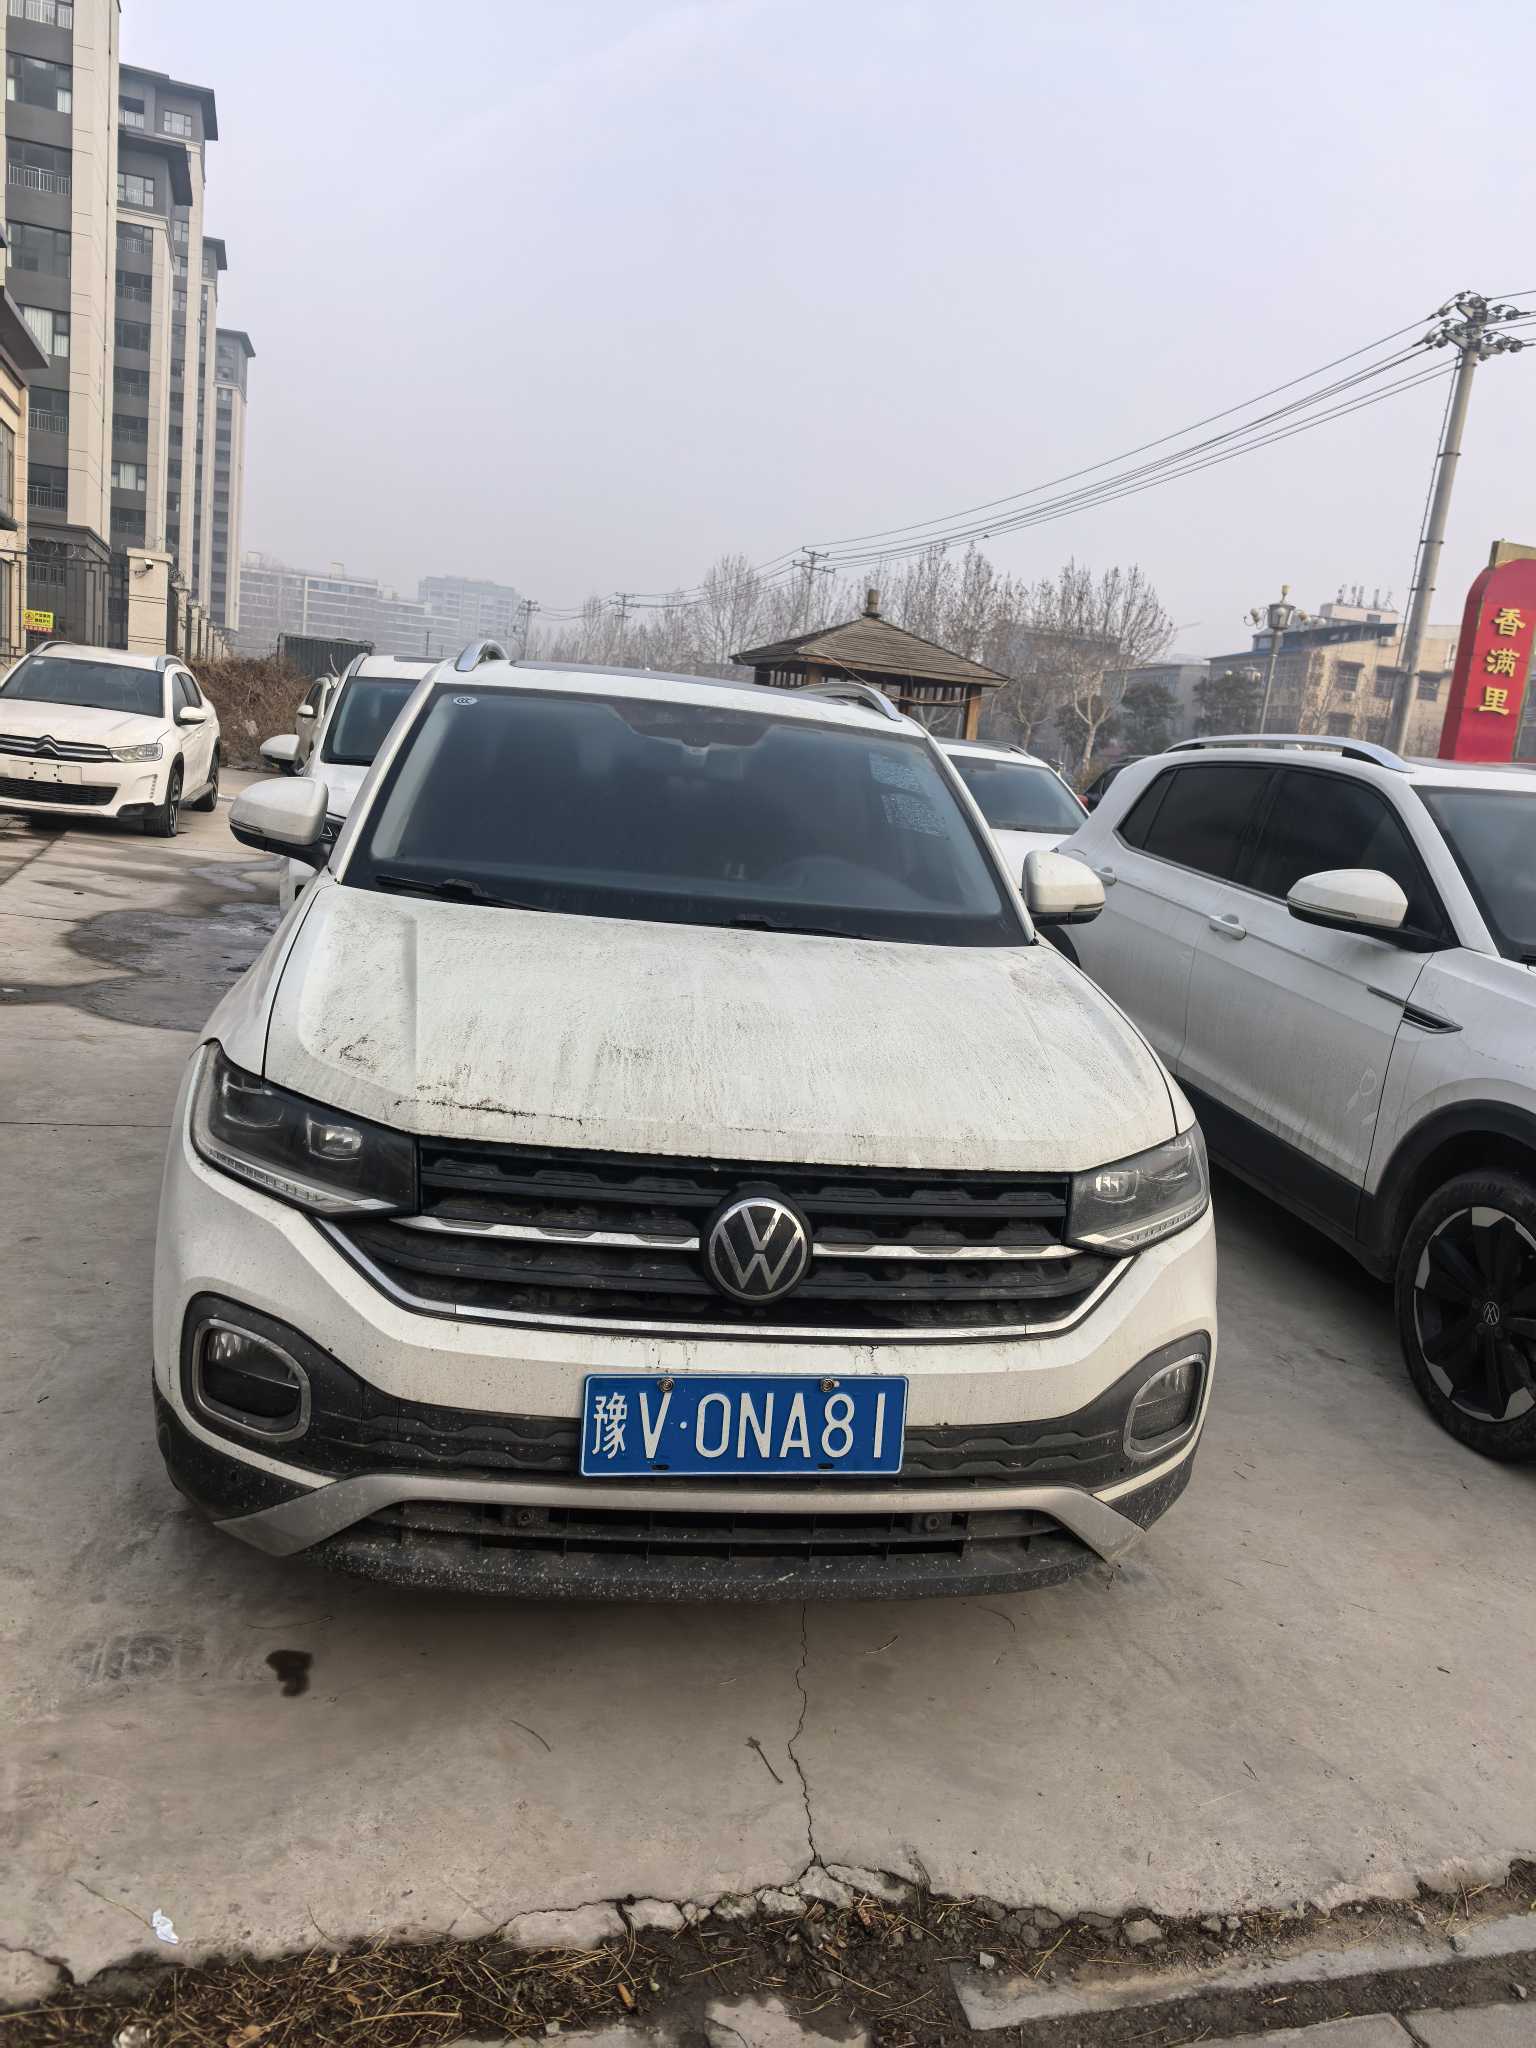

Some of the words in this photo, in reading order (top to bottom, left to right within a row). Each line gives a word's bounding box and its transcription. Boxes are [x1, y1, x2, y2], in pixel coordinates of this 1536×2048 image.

[1478, 607, 1526, 716] 香满里
[717, 1204, 803, 1291] VW
